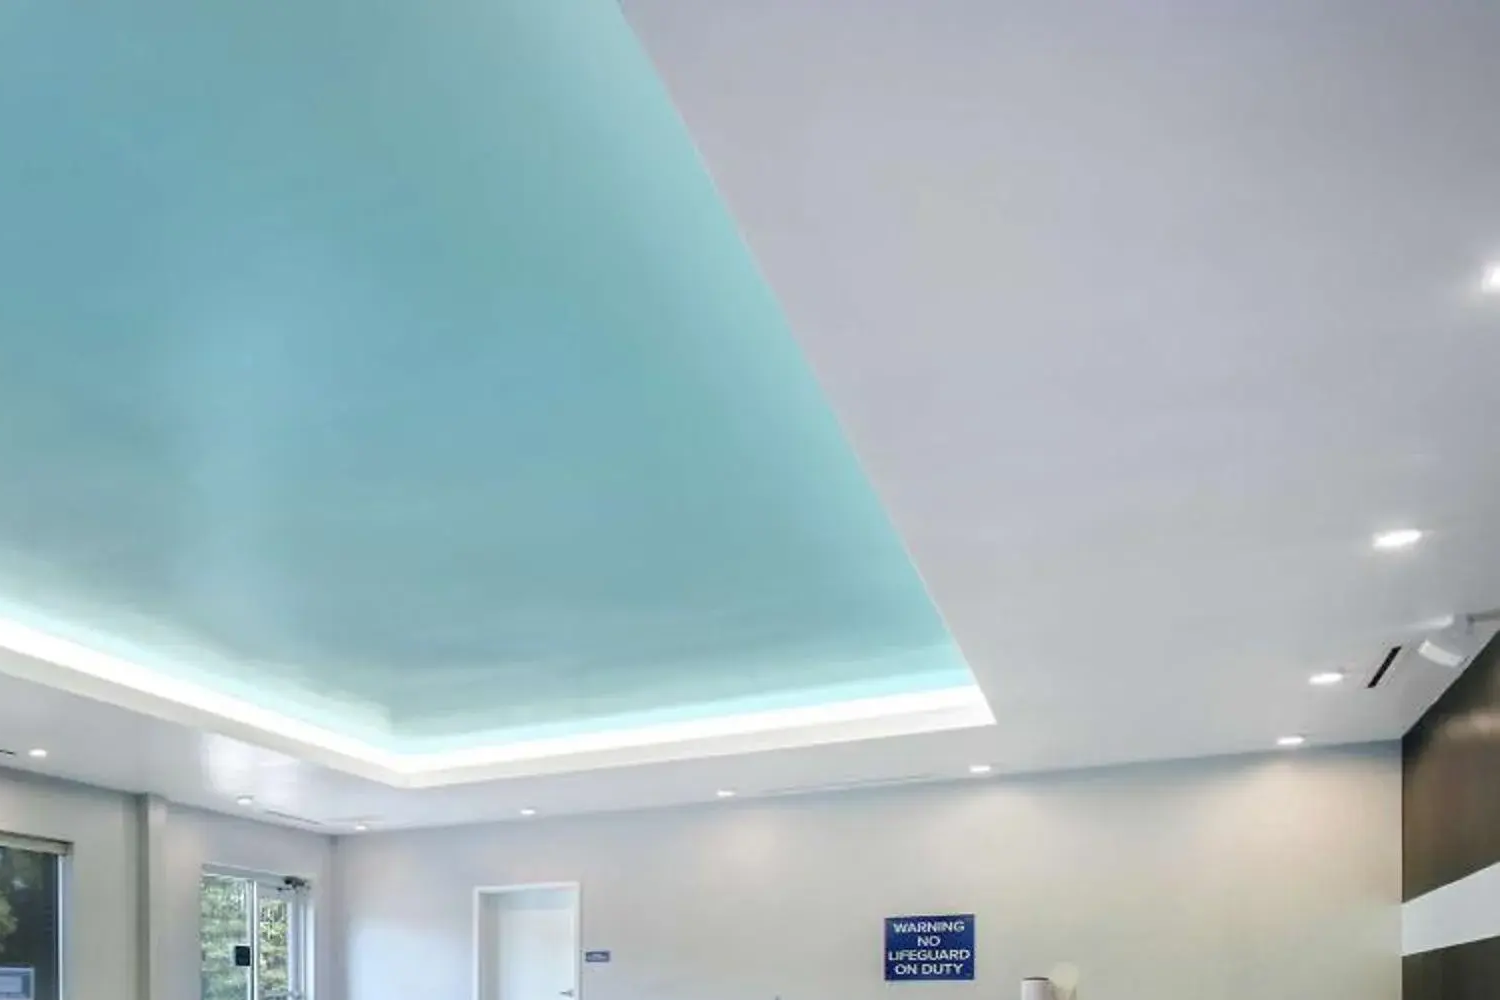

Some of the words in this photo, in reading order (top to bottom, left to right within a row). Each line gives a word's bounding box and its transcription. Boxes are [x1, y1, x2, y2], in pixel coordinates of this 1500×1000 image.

[893, 921, 965, 933] WARNING
[917, 935, 941, 947] NO
[888, 949, 971, 962] LIFEGUARD
[895, 963, 917, 975] ON
[921, 963, 964, 975] DUTY
